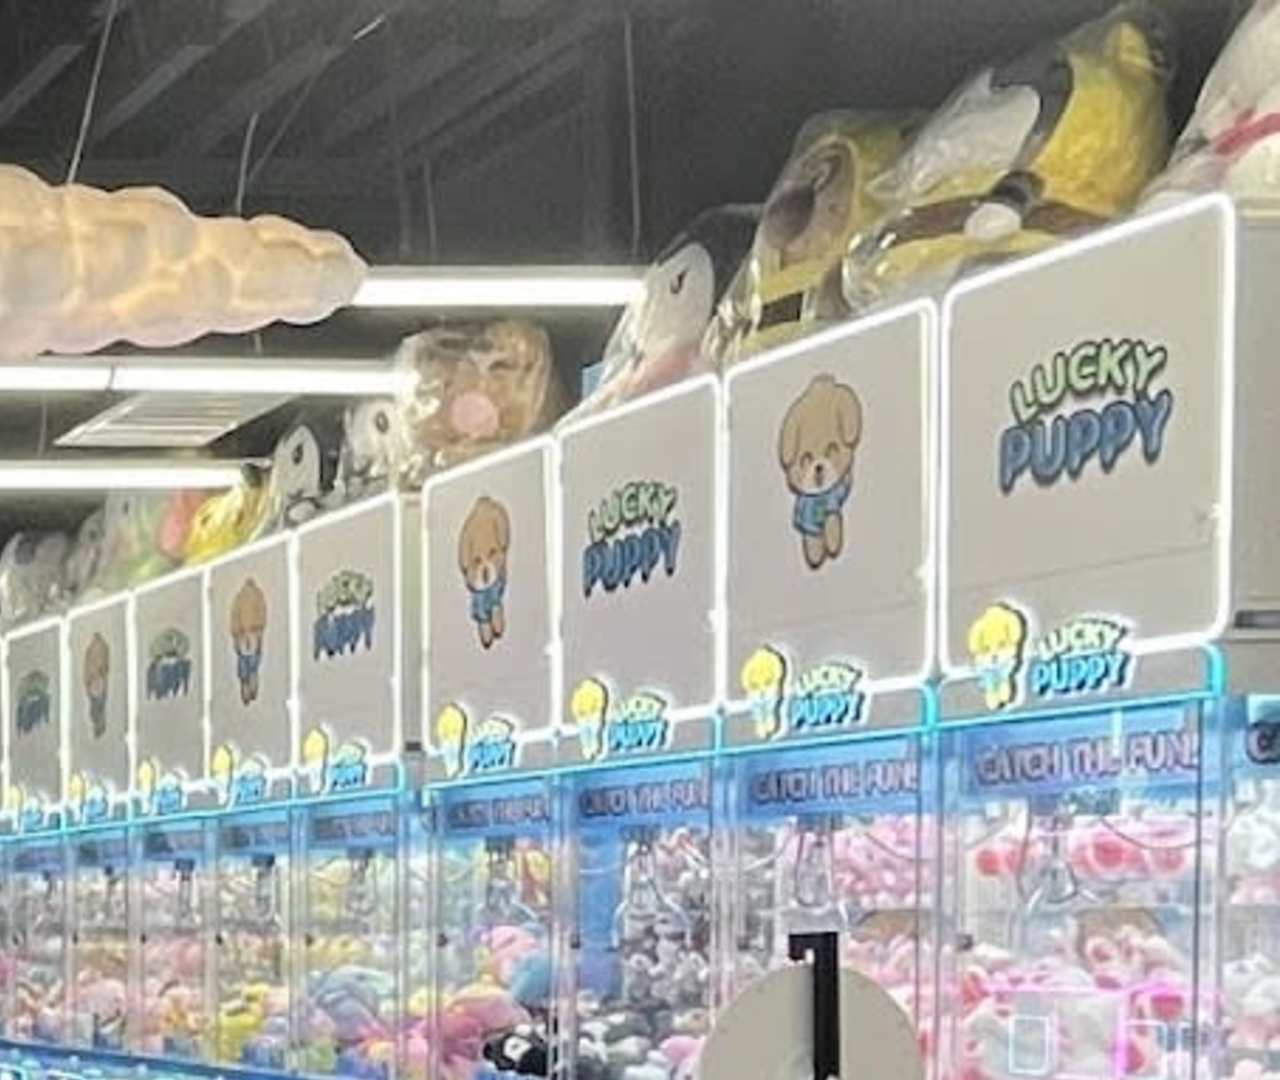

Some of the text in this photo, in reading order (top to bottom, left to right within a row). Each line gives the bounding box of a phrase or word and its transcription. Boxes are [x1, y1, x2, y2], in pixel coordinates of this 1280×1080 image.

[1007, 338, 1168, 426] LUCKY
[1000, 388, 1174, 497] PUPPY
[588, 481, 677, 546] LUCKY
[583, 520, 681, 598] PUPPY
[1041, 618, 1130, 656] LUCKY
[1031, 650, 1132, 695] PUPPY
[792, 690, 865, 729] PUPPY
